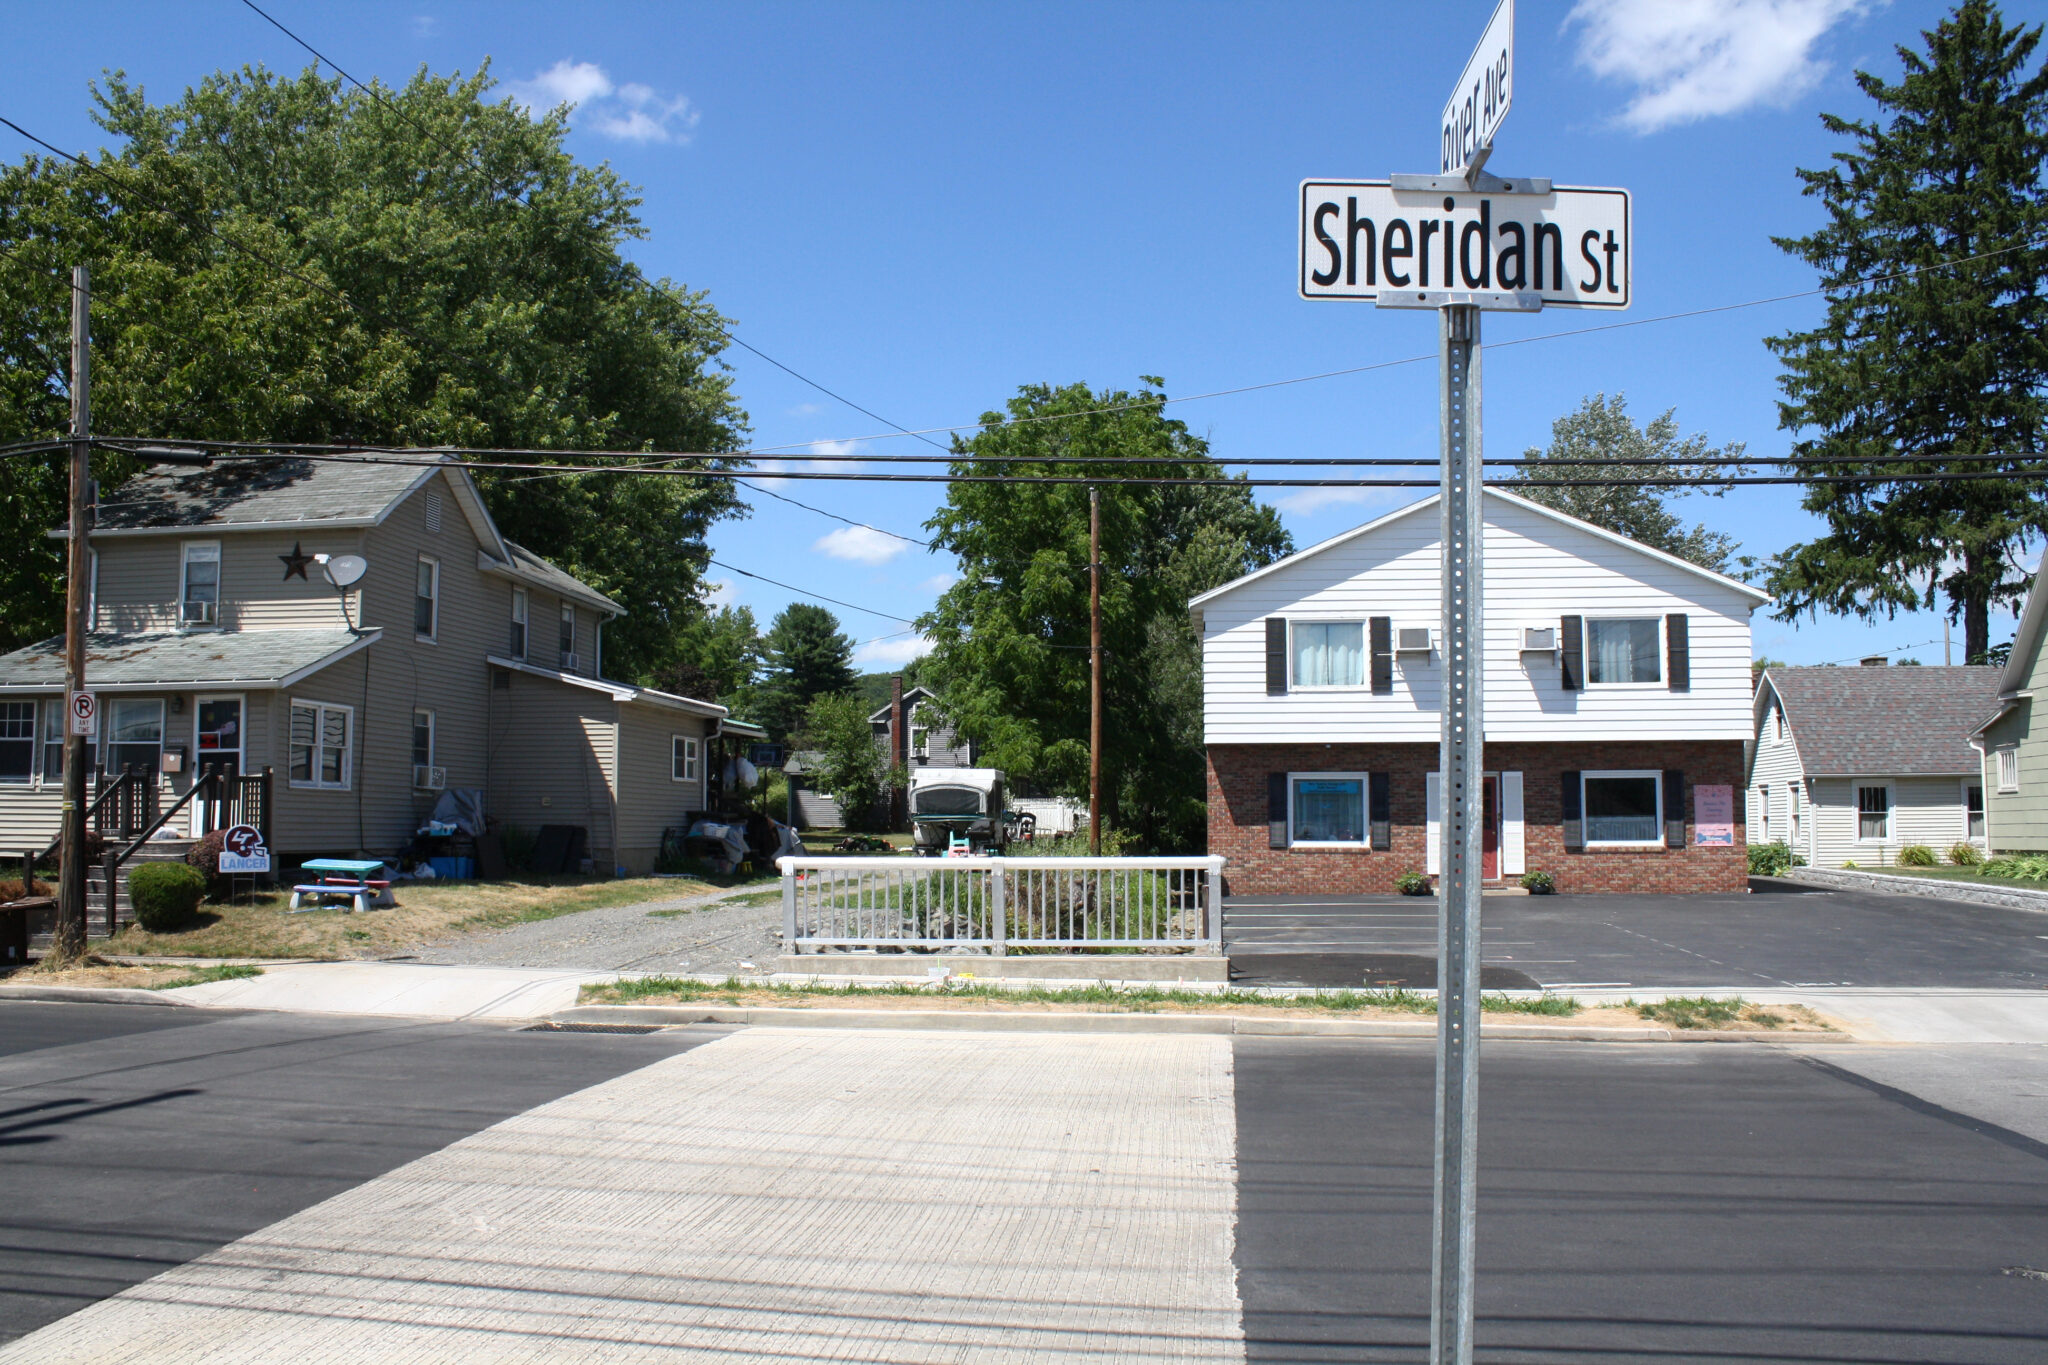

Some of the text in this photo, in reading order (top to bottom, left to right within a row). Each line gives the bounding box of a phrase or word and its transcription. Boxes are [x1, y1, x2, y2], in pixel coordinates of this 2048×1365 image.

[1443, 48, 1507, 174] River Ave
[1311, 196, 1619, 294] Sheridan St
[221, 858, 267, 869] LANCER
